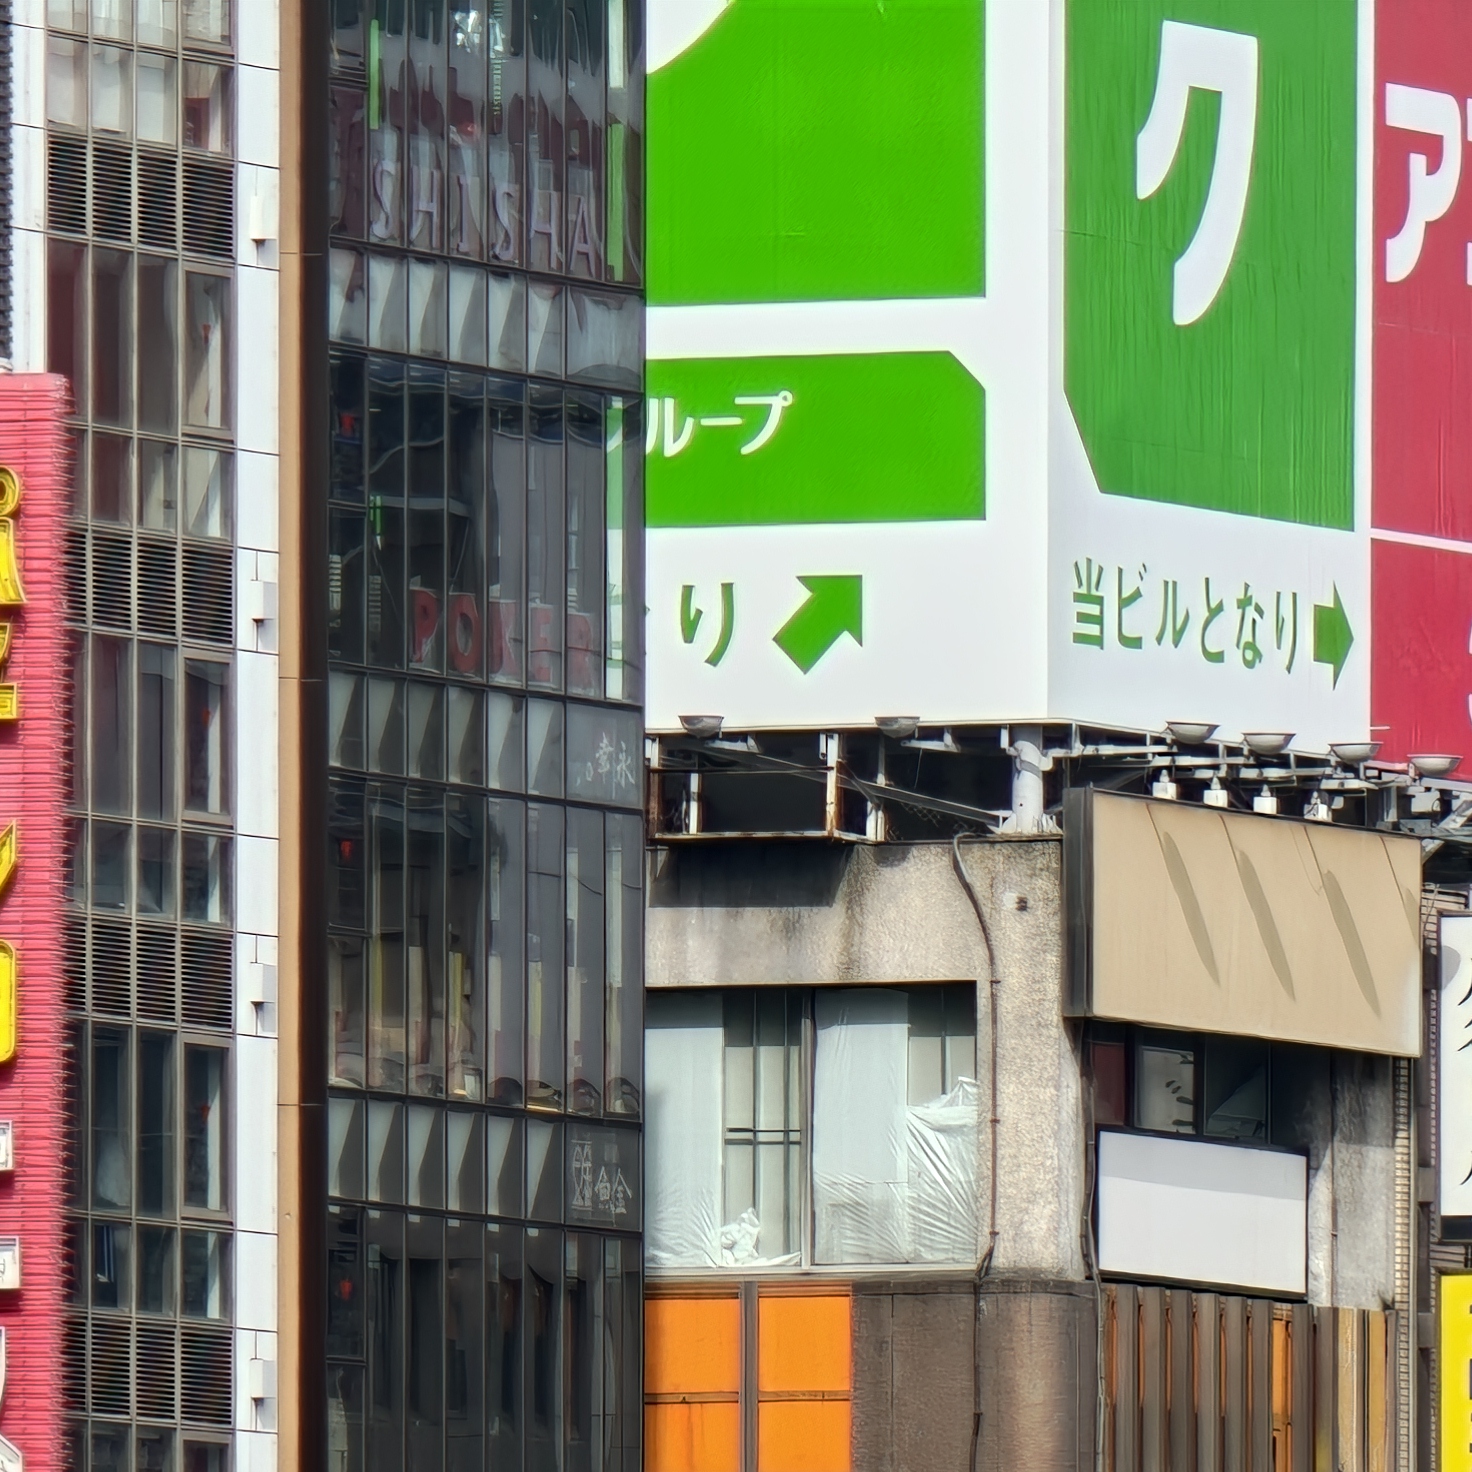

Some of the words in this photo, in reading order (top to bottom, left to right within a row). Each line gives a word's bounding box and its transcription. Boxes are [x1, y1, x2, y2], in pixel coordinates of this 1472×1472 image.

[369, 157, 601, 280] SHISHA
[646, 389, 793, 457] ループ
[1072, 558, 1301, 673] 当ビルとなり
